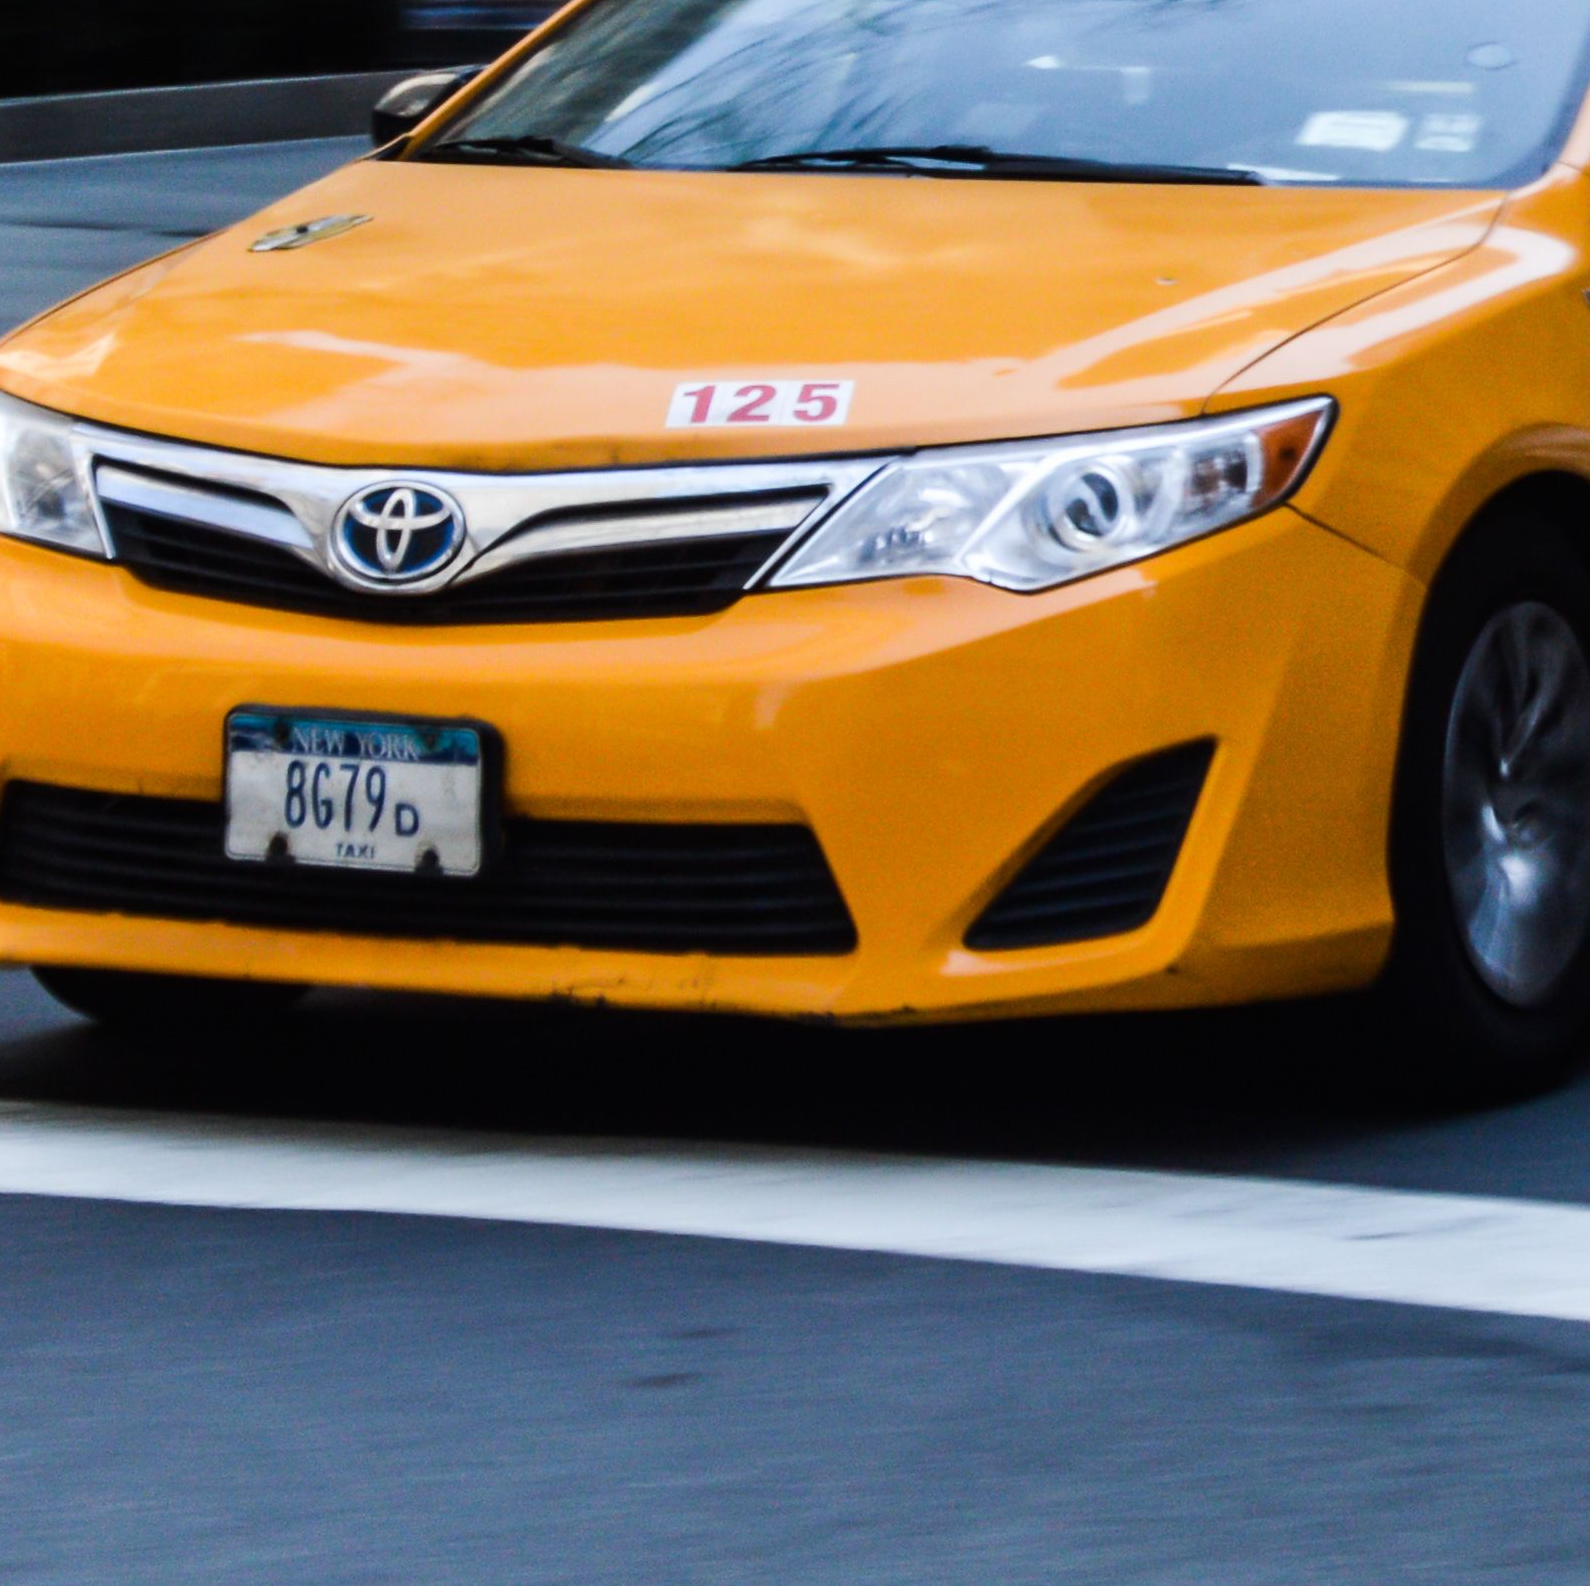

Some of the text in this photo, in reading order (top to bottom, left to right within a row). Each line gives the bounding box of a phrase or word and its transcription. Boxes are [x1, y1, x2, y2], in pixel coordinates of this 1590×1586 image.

[682, 382, 841, 425] 125
[291, 726, 420, 761] NEW YORK
[336, 842, 376, 860] TAXI
